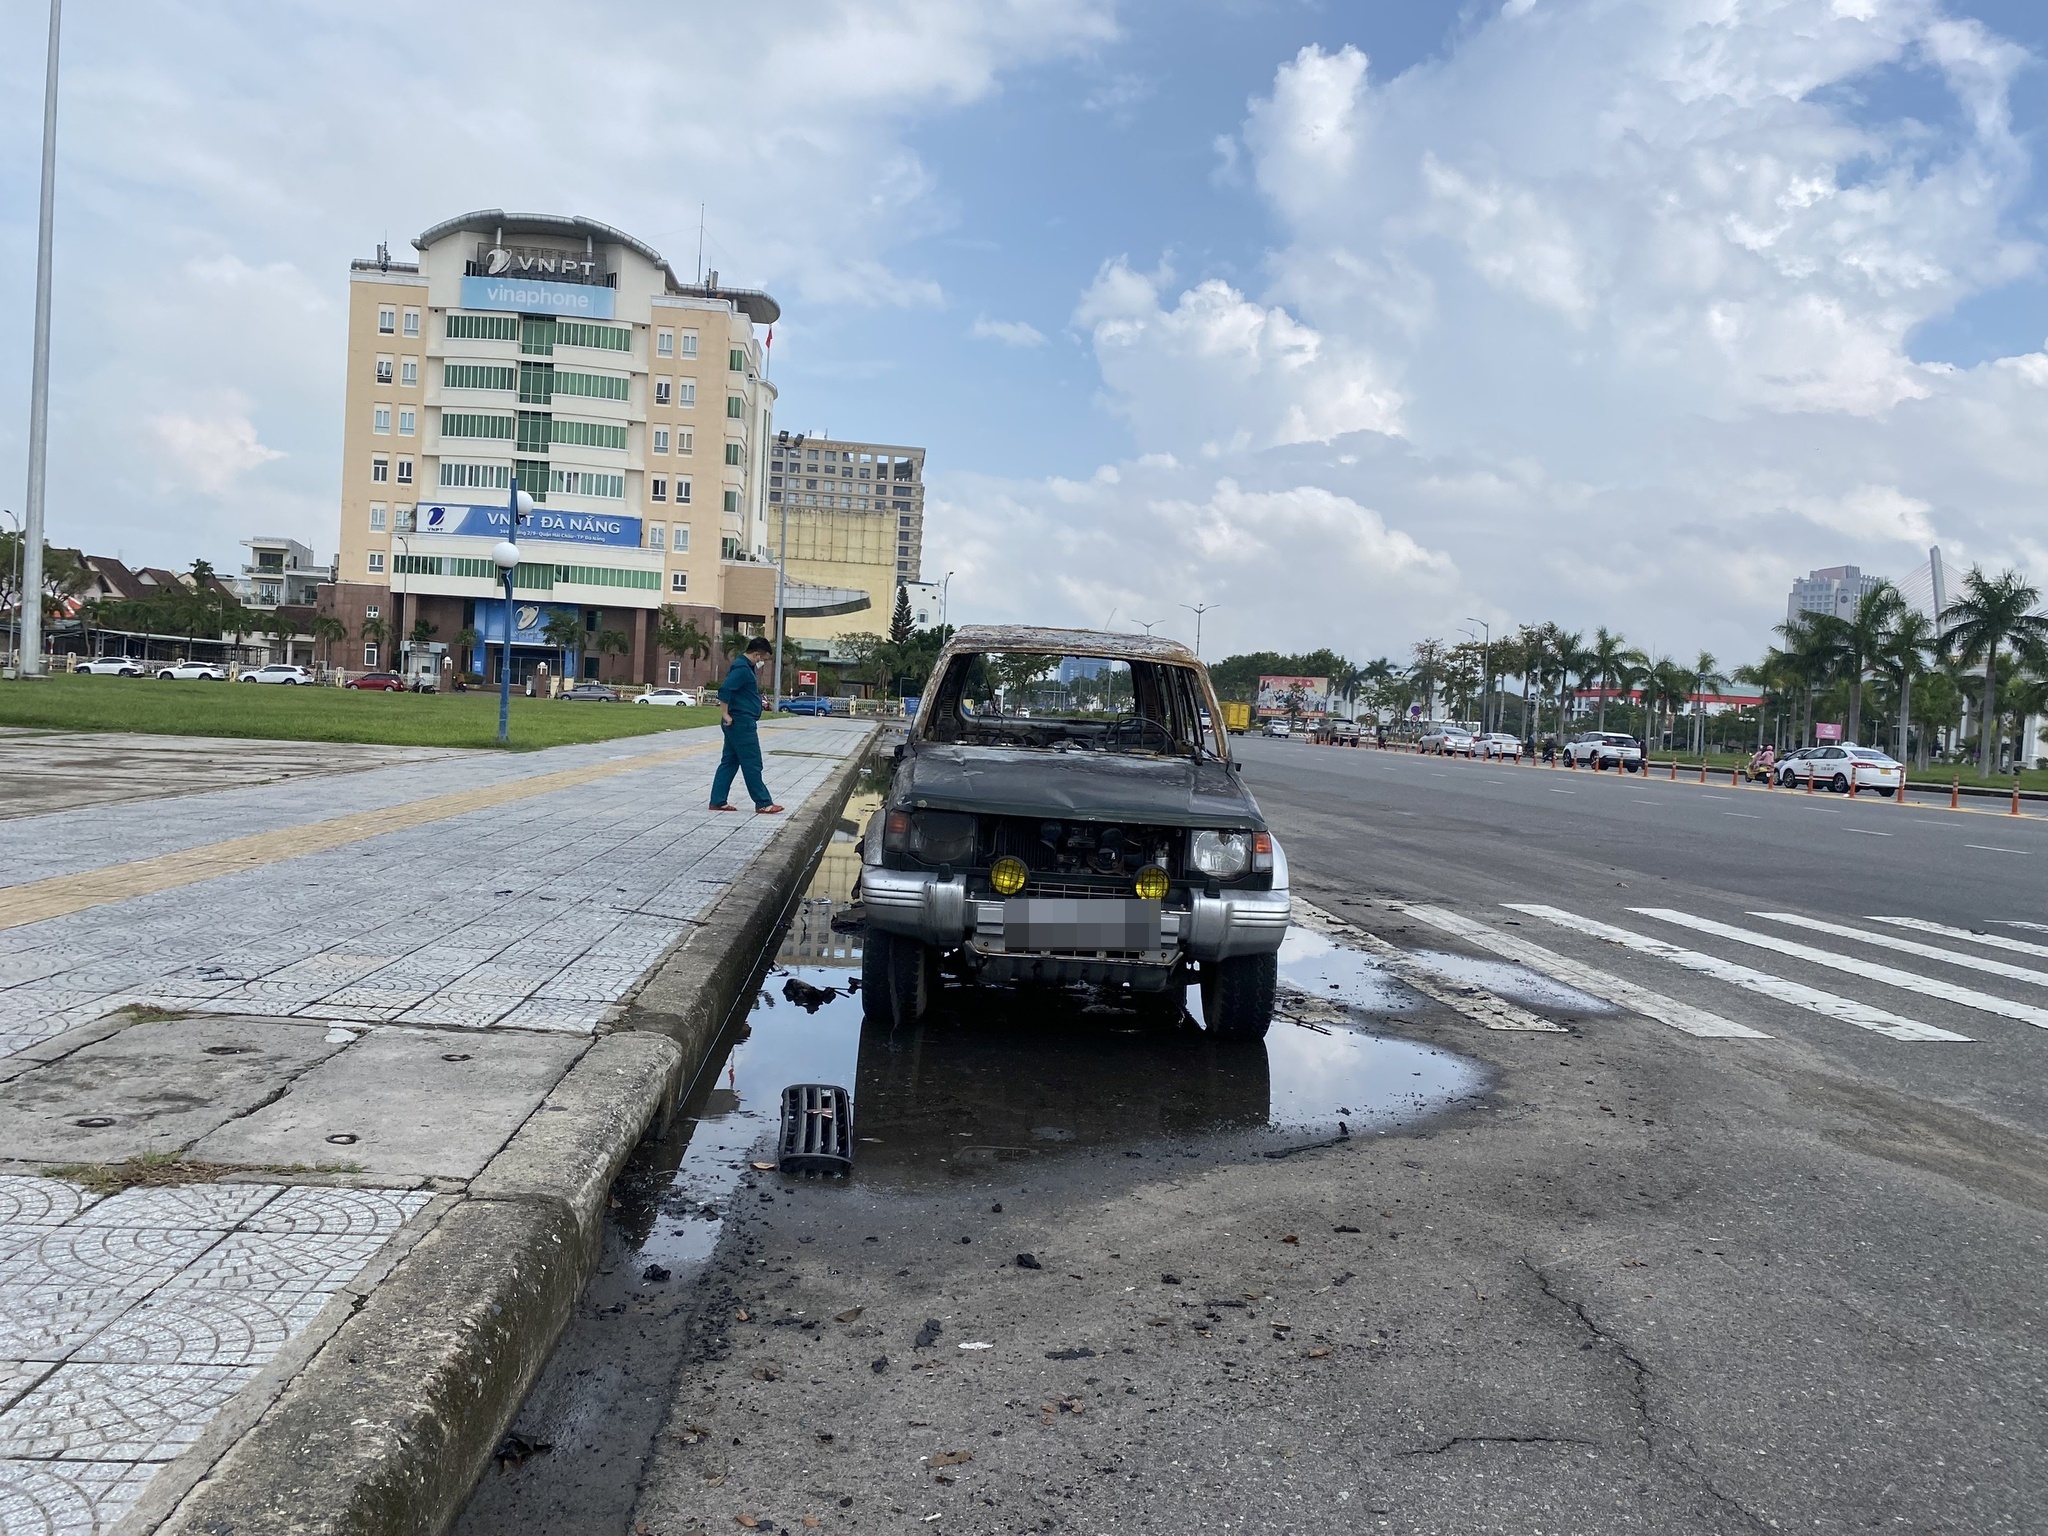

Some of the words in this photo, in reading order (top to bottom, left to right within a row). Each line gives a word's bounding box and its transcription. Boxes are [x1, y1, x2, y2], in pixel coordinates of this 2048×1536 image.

[517, 256, 595, 276] VNPT
[487, 284, 589, 308] vinaphone
[487, 512, 534, 527] VNT
[540, 514, 566, 530] ĐÀ
[569, 515, 621, 534] NẴNG
